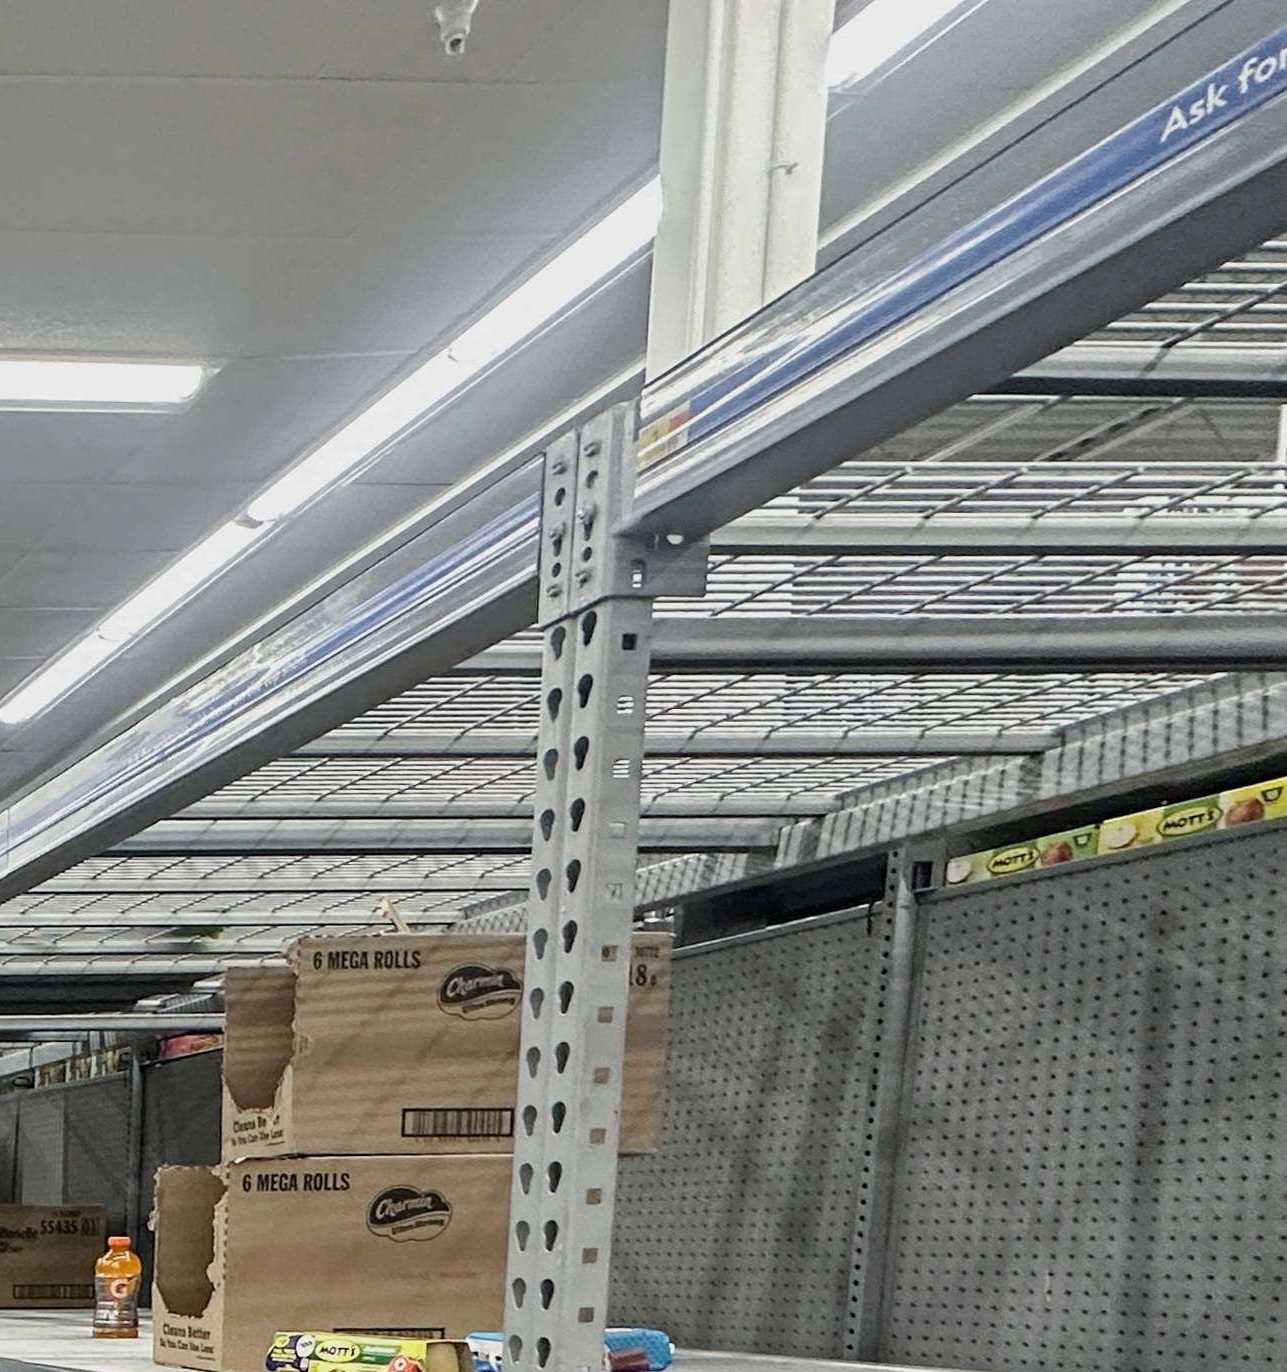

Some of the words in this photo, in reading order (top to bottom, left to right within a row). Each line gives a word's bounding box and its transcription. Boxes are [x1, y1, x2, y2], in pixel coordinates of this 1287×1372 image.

[1160, 83, 1229, 142] Ask
[314, 953, 322, 970] 6
[327, 951, 368, 970] MEGA
[374, 950, 421, 969] ROLLS
[242, 1177, 252, 1192] 6
[257, 1174, 298, 1192] MEGA
[303, 1173, 350, 1191] ROLLS
[376, 1194, 433, 1219] Charmin
[40, 1218, 78, 1236] 55435
[187, 1325, 211, 1341] Better
